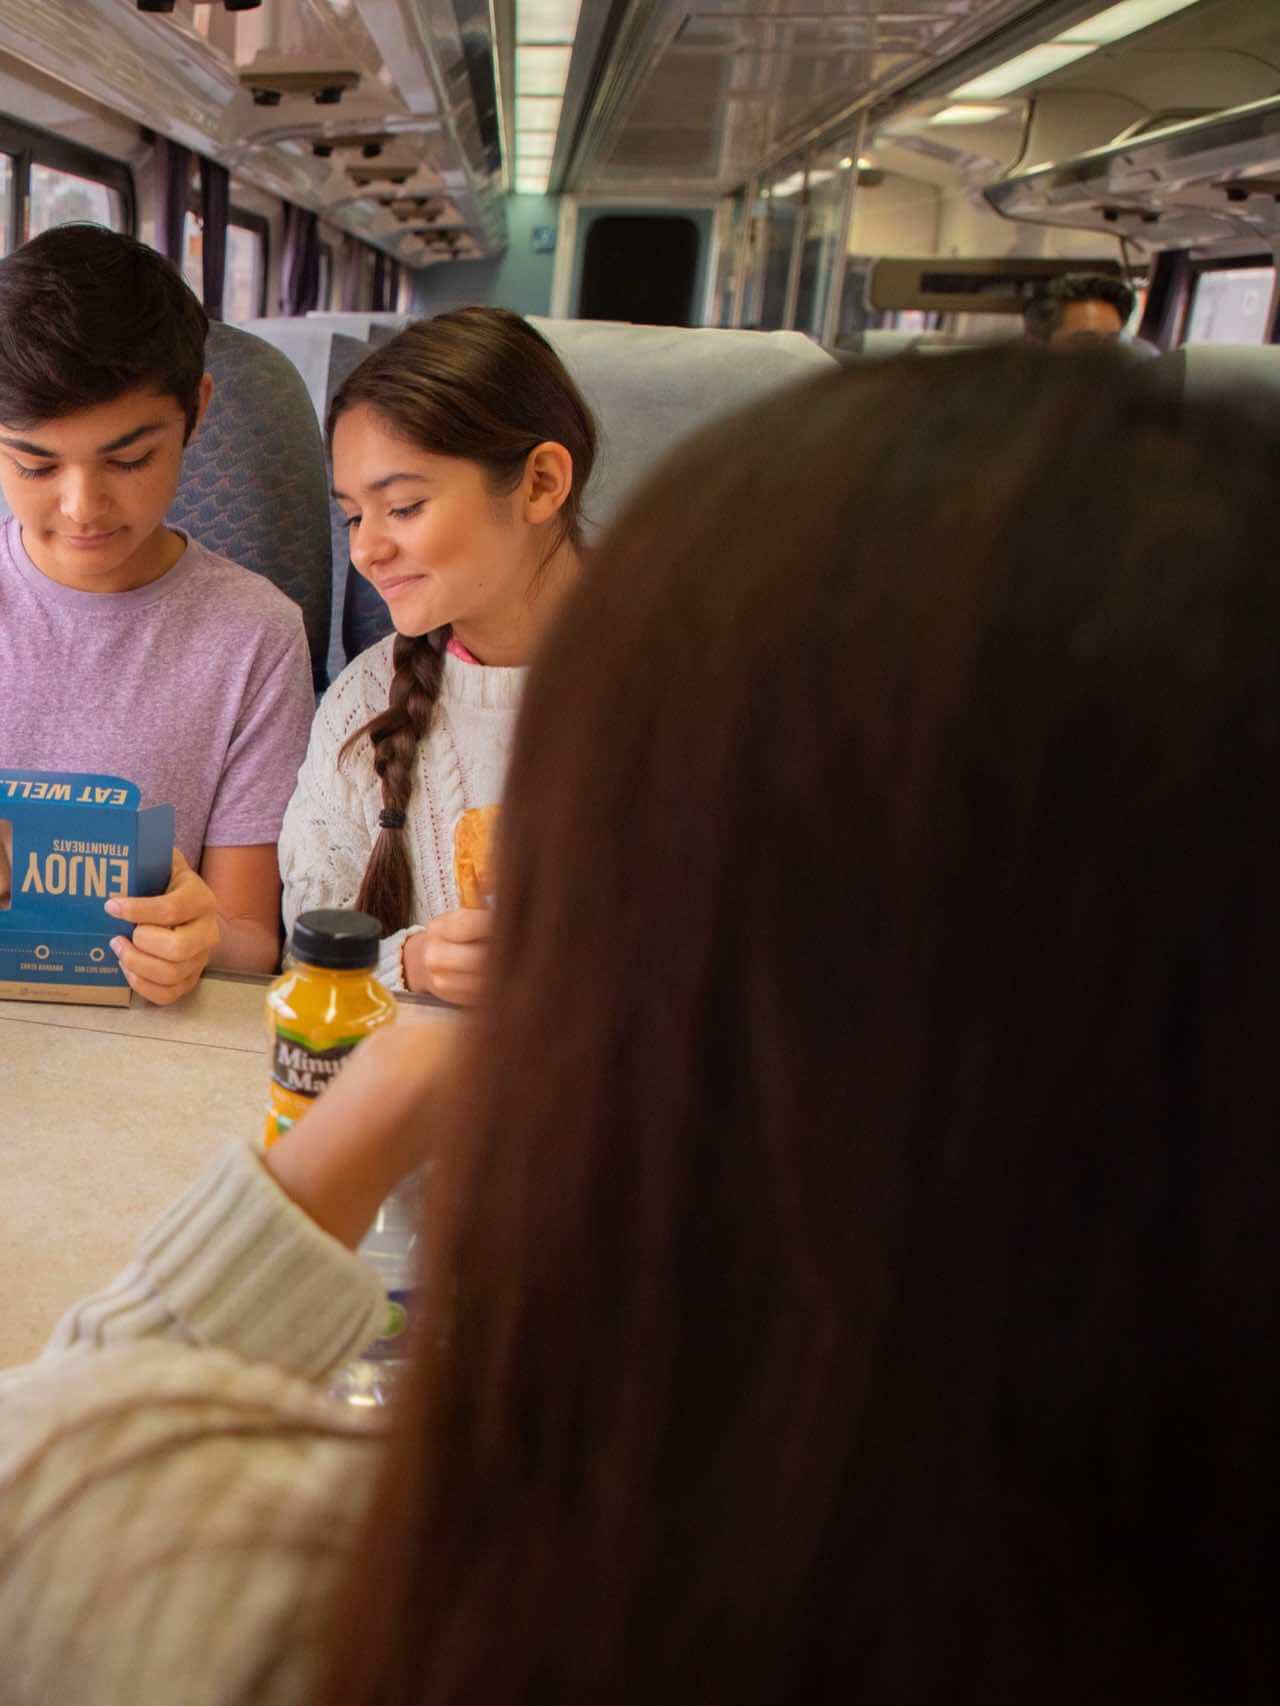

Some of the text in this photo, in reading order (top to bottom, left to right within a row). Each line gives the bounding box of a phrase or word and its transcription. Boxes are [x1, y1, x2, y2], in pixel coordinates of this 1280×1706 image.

[76, 786, 128, 805] EAT
[21, 852, 129, 898] ENJOY
[277, 1043, 340, 1073] Minu
[287, 1068, 330, 1092] Ma
